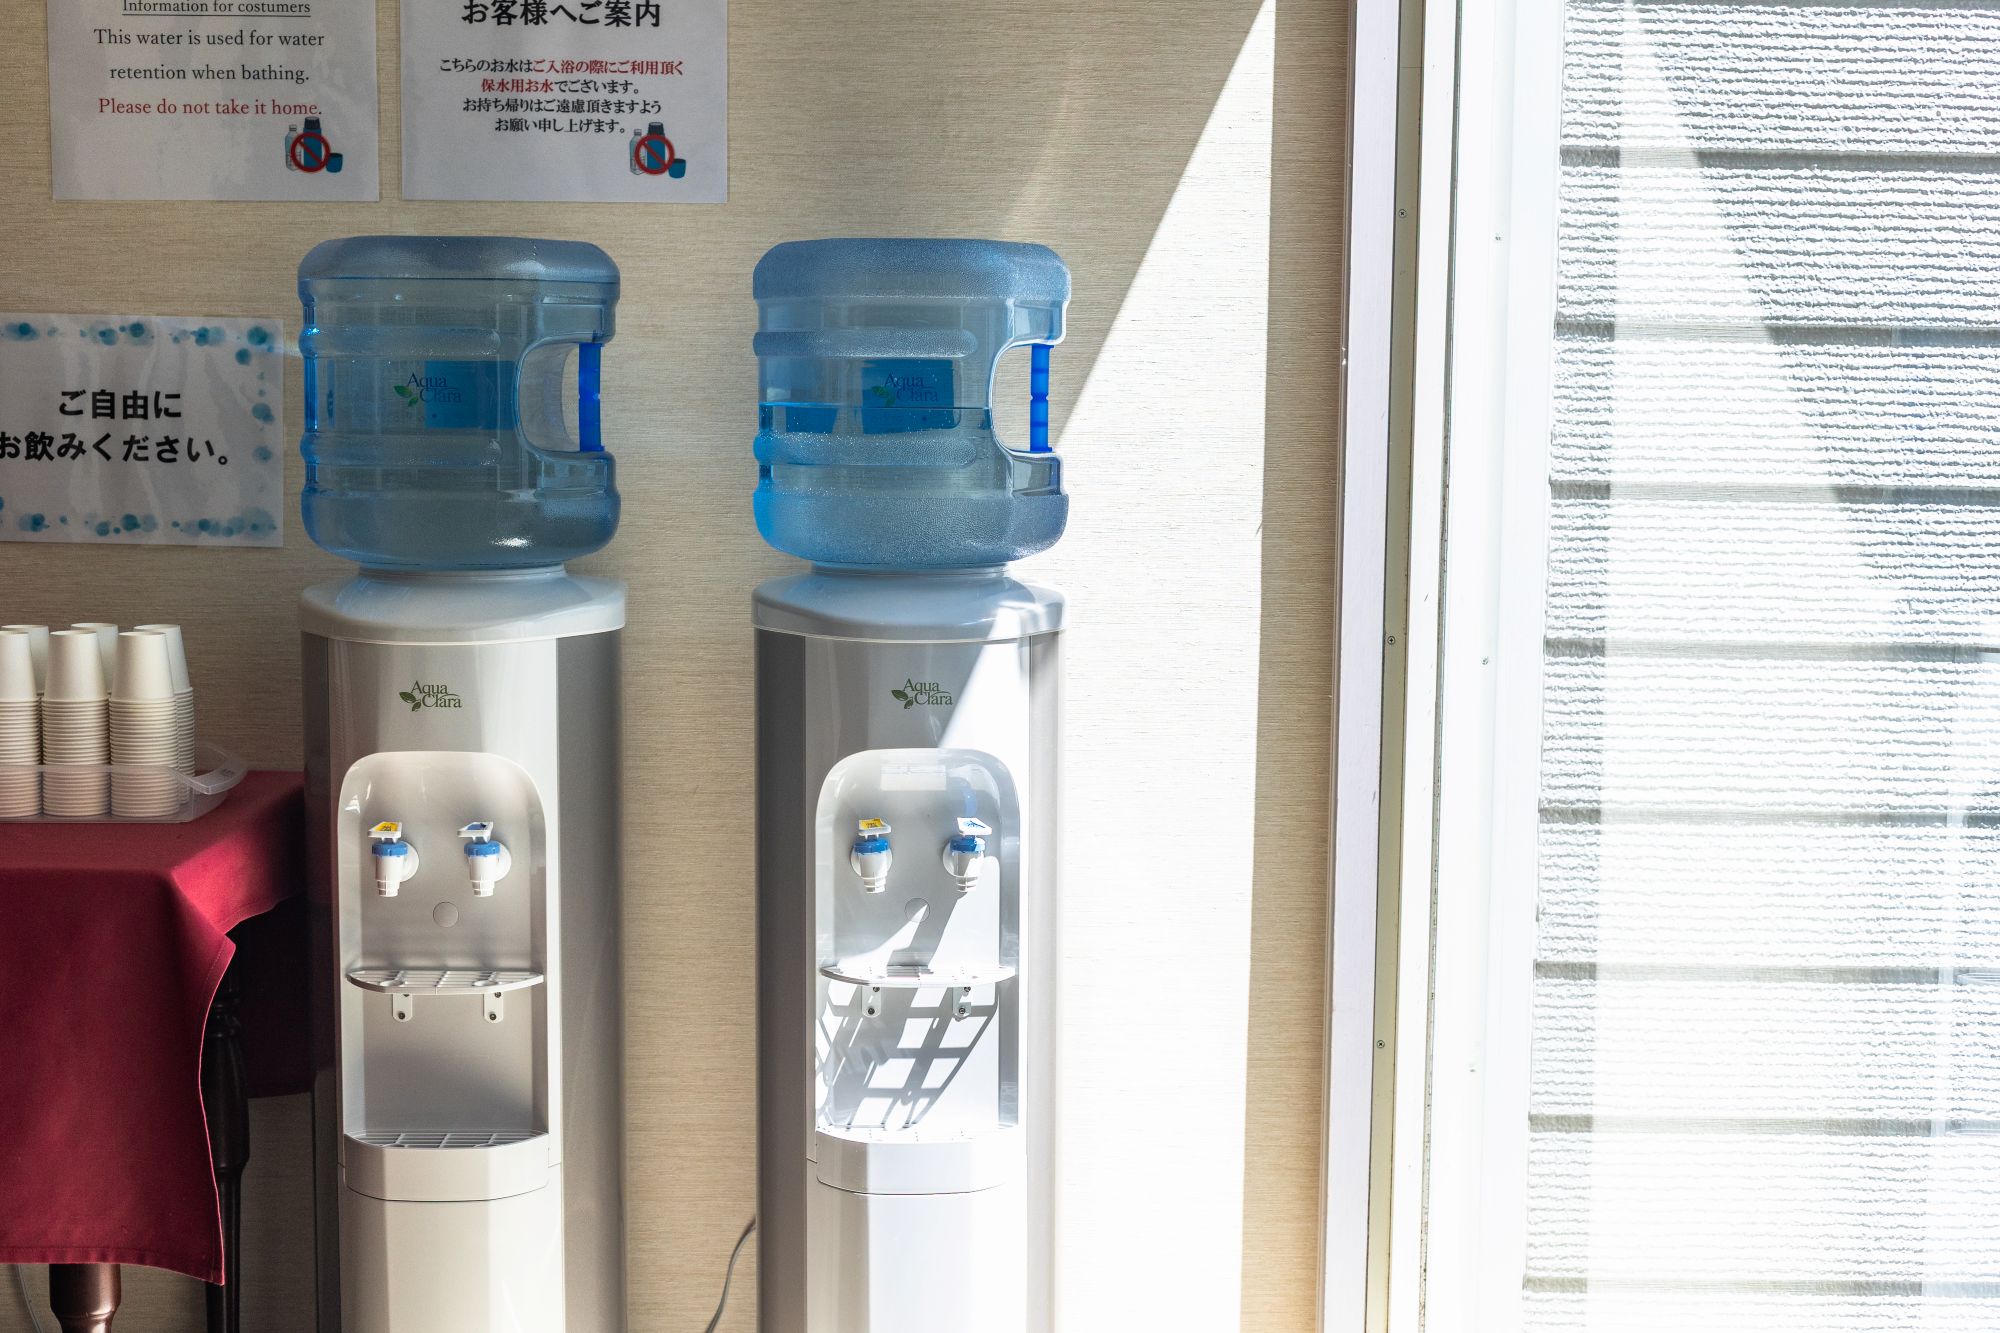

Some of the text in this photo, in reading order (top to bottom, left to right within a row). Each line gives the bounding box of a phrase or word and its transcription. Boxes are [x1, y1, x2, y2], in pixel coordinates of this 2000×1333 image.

[121, 0, 311, 14] Information for costumers
[461, 0, 661, 28] お客様へご案内
[94, 28, 325, 47] This water is used for water
[110, 64, 310, 84] retention when bathing.
[440, 58, 684, 75] こちらのお水はご入浴の際にご利用頂く
[481, 78, 639, 95] 保水用お水でございます。
[98, 98, 322, 116] Please do not take it home.
[462, 97, 662, 114] お持ち帰りはご遠慮頂きますよう
[494, 118, 625, 134] お願い申し上げます。
[407, 372, 447, 390] Aqua
[884, 373, 924, 390] Aqua
[419, 387, 462, 403] Clara
[896, 386, 938, 402] Clara
[59, 389, 182, 421] ご自由に
[0, 431, 228, 465] お飲みください。
[411, 680, 448, 695] Aqua
[903, 678, 940, 693] Aqua
[422, 693, 462, 708] Clara
[914, 690, 952, 705] Clara
